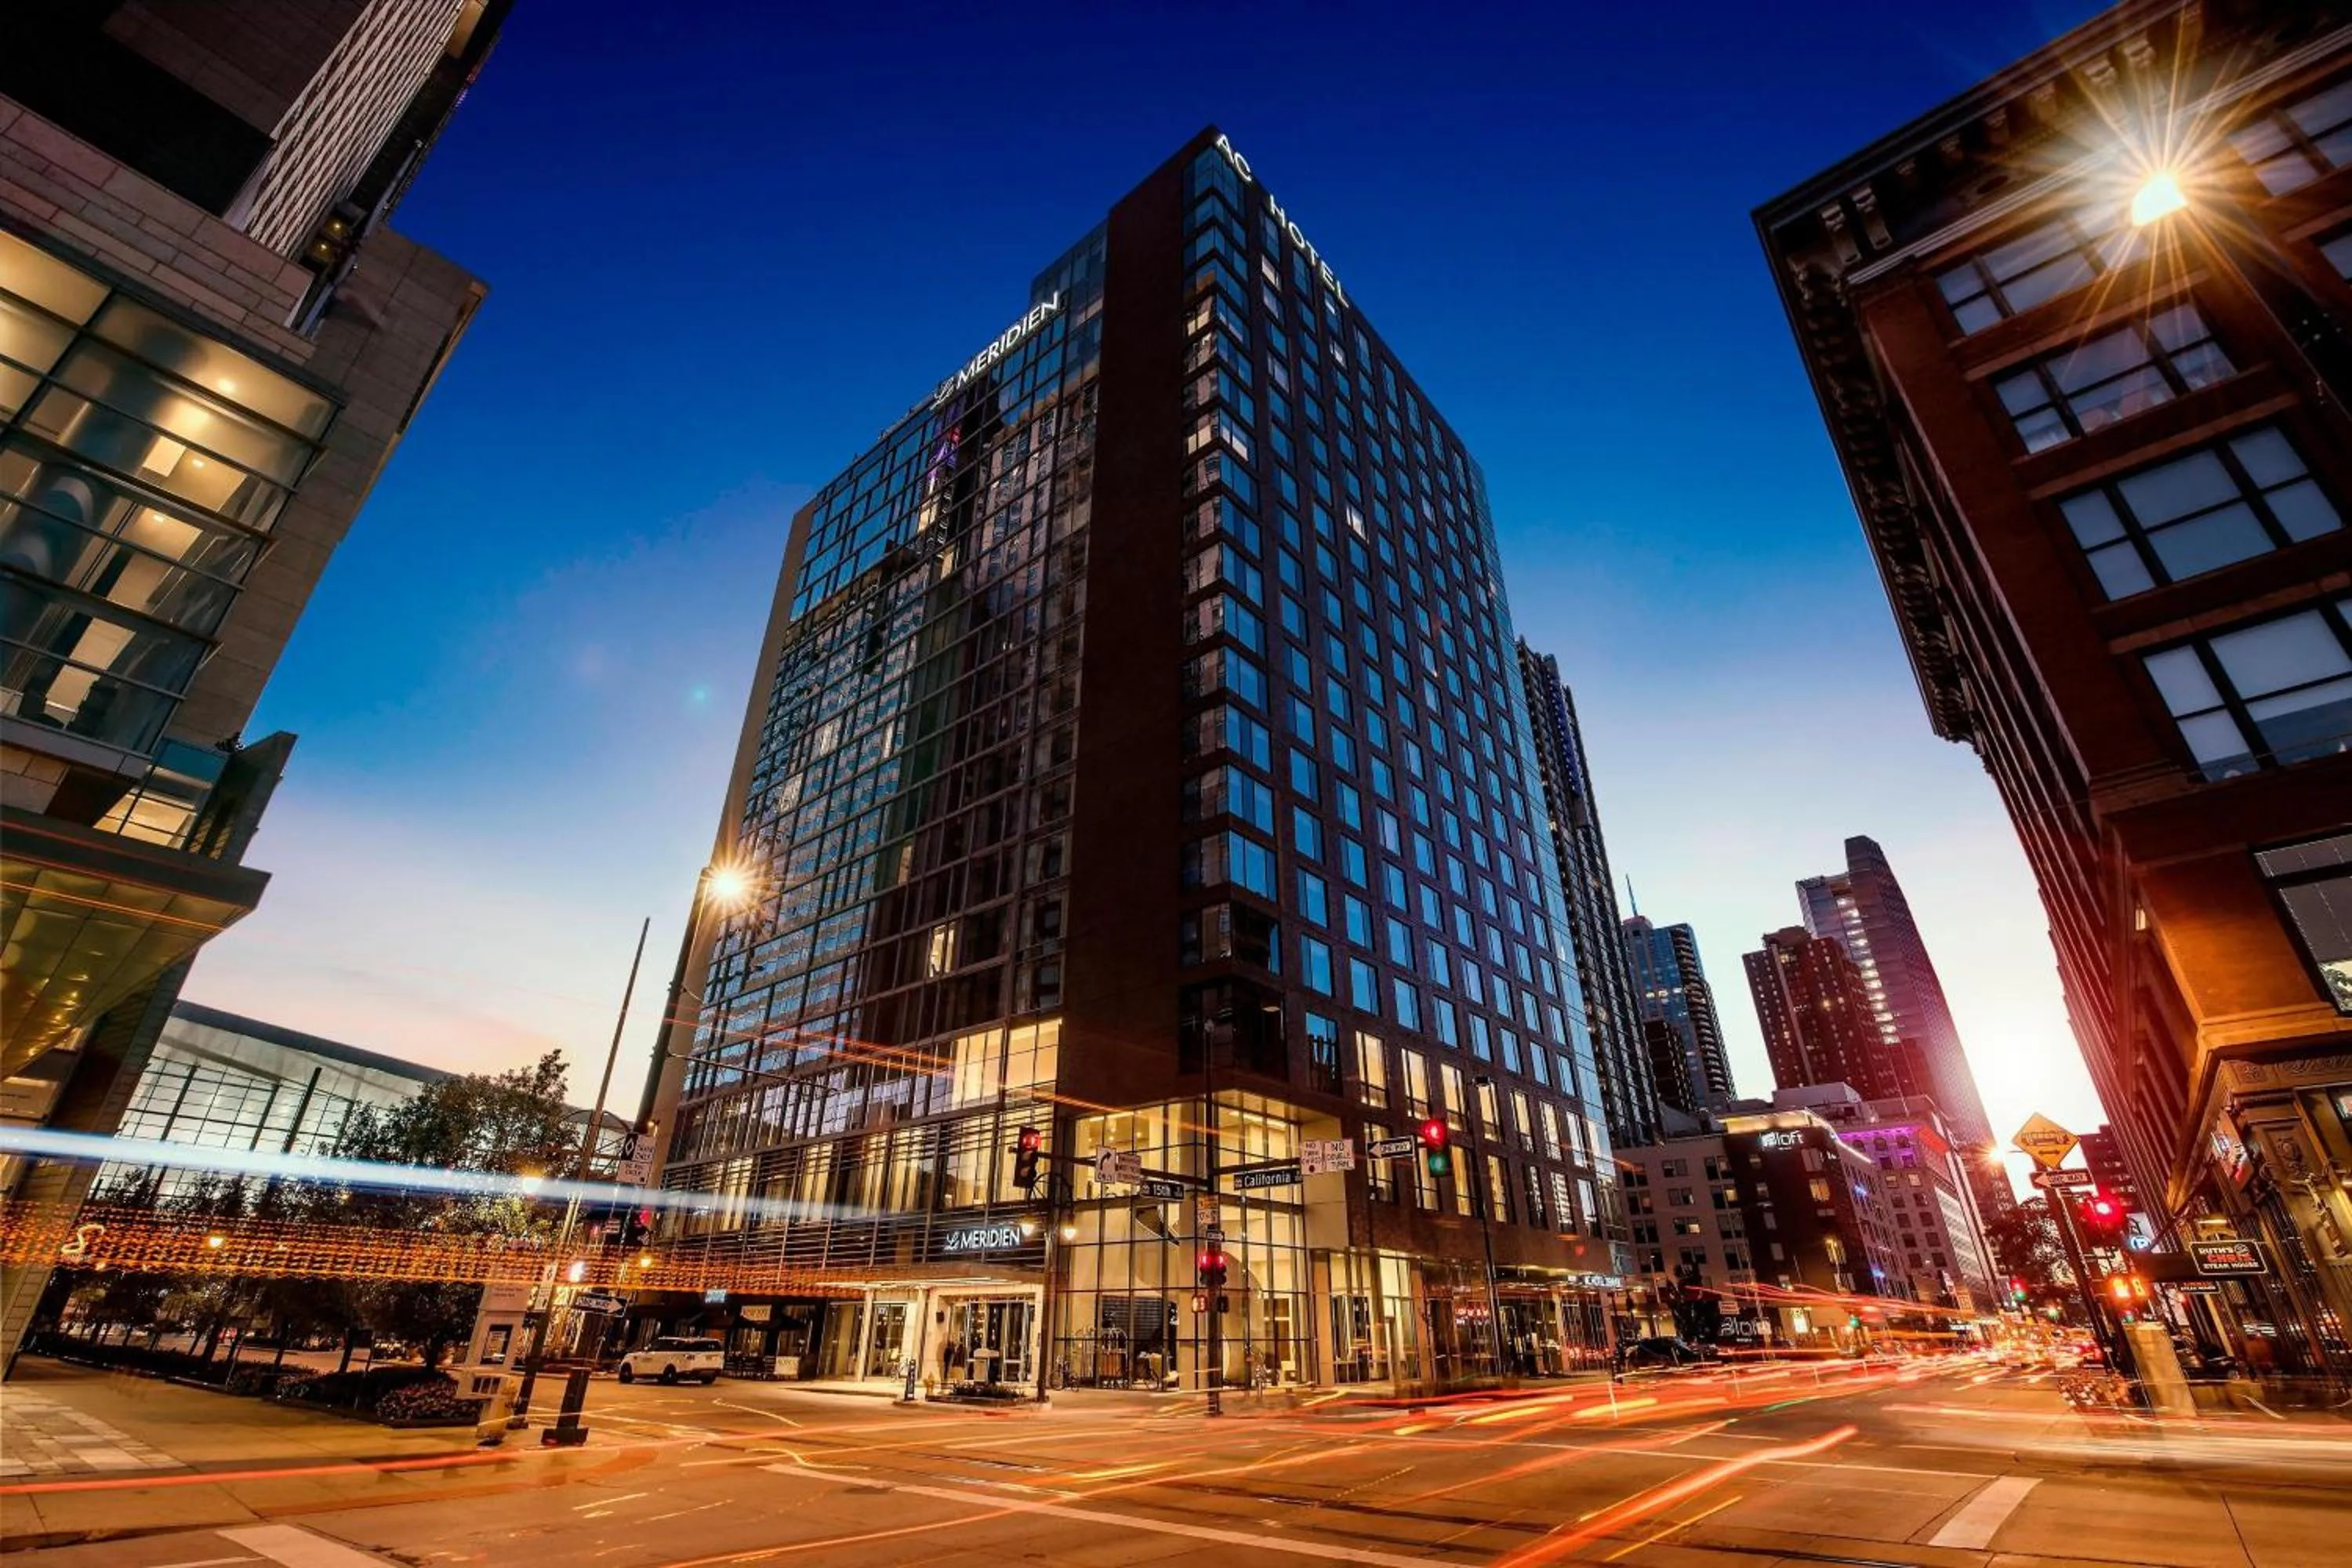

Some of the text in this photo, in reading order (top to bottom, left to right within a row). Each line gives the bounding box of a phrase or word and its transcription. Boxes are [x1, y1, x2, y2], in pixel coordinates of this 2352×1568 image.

[1217, 134, 1349, 308] AC HOTEL
[956, 291, 1058, 390] MERIDIEN
[1331, 1142, 1344, 1152] NO
[1244, 1171, 1290, 1187] California
[960, 1226, 1020, 1249] MERIDIEN
